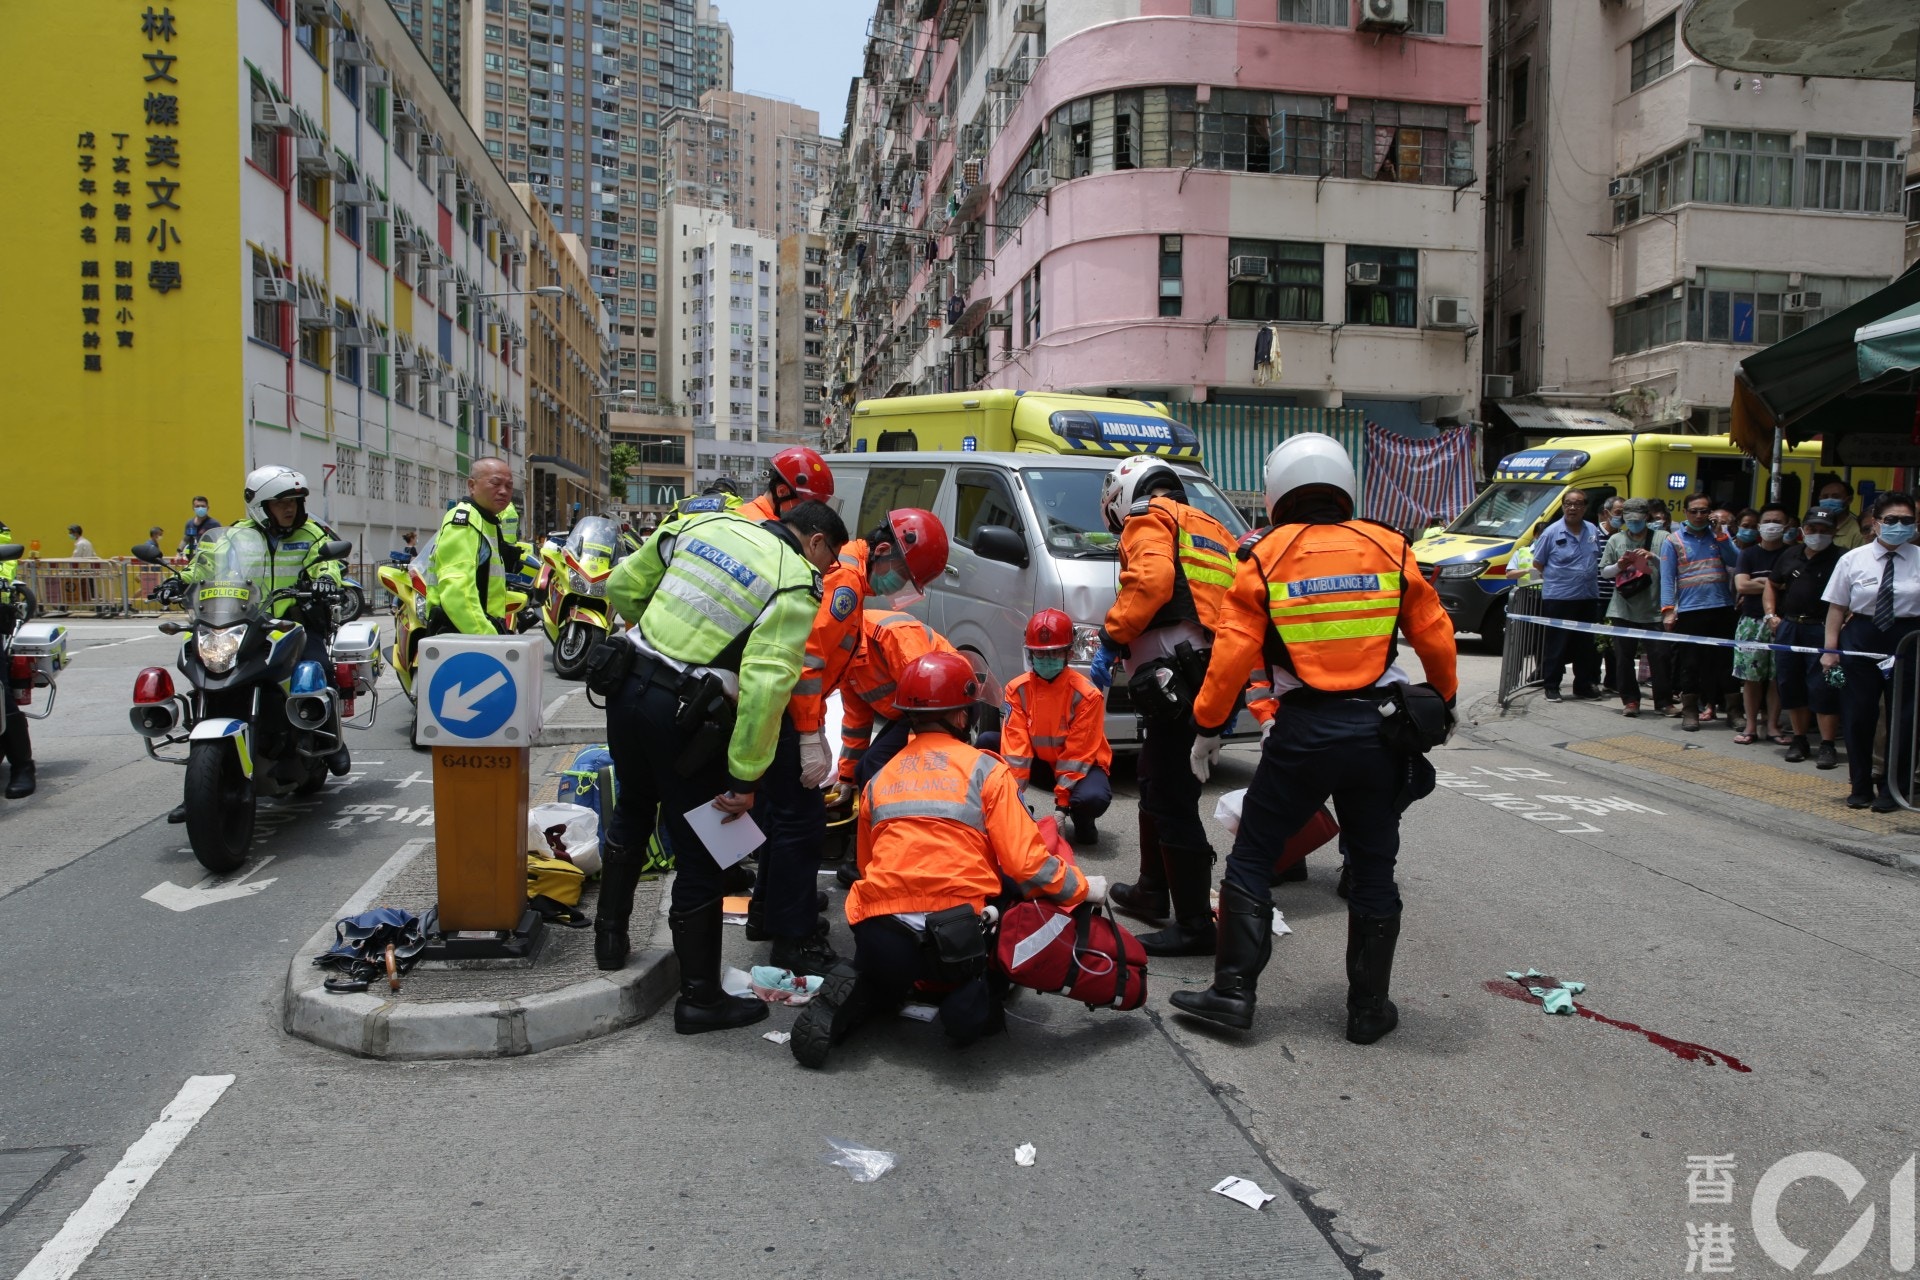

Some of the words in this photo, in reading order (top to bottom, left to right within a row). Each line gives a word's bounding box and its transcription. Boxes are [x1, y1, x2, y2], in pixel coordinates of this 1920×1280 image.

[141, 7, 181, 294] 林文燦英文小學
[1102, 421, 1171, 439] AMBULANCE
[1508, 457, 1551, 467] AMBULANCE
[699, 546, 740, 573] POLICE
[207, 589, 239, 597] POLICE
[1306, 577, 1363, 592] AMBULANCE
[442, 754, 512, 769] 64039
[896, 751, 950, 774] 救護
[879, 776, 959, 797] AMBULANCE
